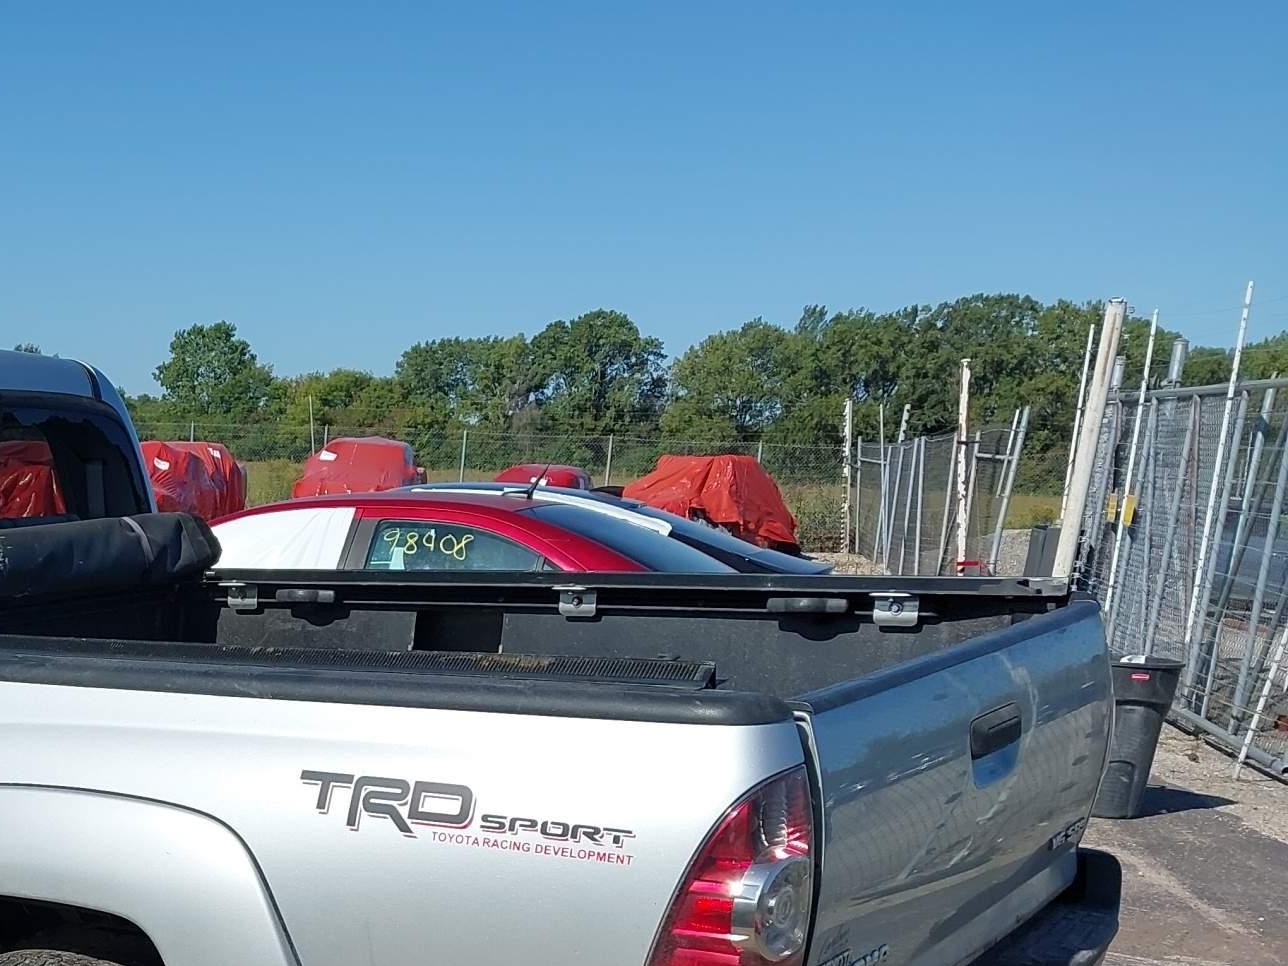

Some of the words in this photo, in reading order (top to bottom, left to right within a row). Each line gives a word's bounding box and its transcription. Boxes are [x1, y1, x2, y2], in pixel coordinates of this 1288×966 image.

[300, 769, 477, 839] TRD
[480, 813, 637, 848] SPORT
[431, 831, 480, 847] TOYOTA
[482, 837, 532, 854] RACING
[534, 842, 635, 866] DEVELOPMENT
